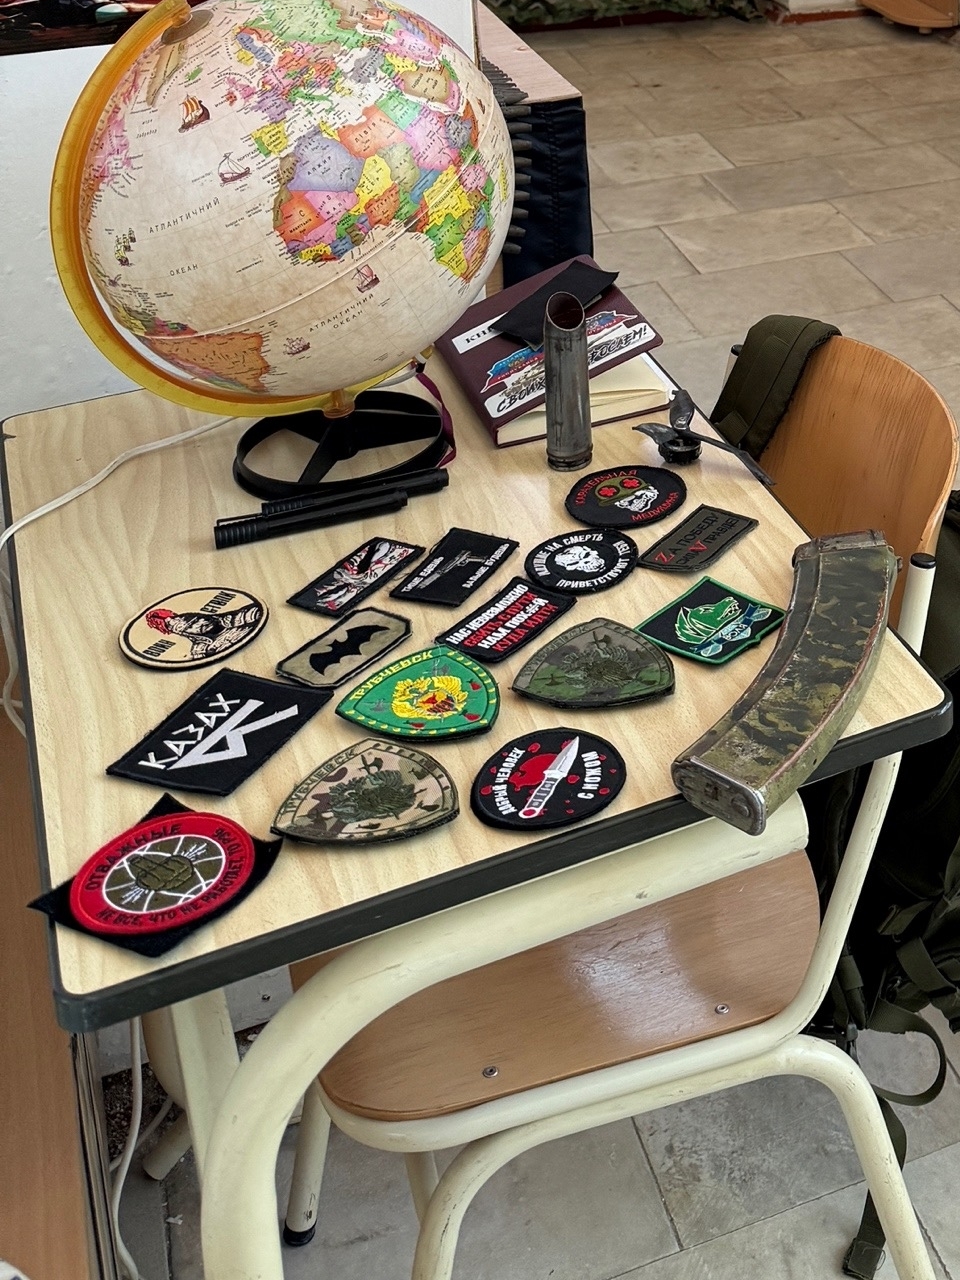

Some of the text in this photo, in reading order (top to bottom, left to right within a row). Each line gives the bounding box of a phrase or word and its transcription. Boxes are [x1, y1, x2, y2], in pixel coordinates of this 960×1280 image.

[307, 155, 332, 176] АЛЖИР
[149, 196, 220, 234] АТЛАНТИЧНИЙ
[169, 263, 199, 277] ОКЕАН
[309, 293, 374, 333] АТЛАНТИЧНИЙ
[333, 310, 363, 329] ОКЕАН
[497, 378, 546, 413] СВОИХ
[575, 470, 637, 507] КАРАТЕЛЬНАЯ
[545, 541, 563, 552] НА
[562, 533, 604, 545] СМЕРТЬ
[679, 512, 719, 546] ПОБЕДУ
[556, 558, 630, 588] ПРИВЕТСТВУЮТ
[446, 583, 529, 645] НАС НЕВОЗМОЖНО
[463, 591, 538, 648] СБИТЬ С ПУТИ
[492, 603, 559, 653] КУДА ИДТИ
[478, 627, 511, 649] НАМ
[349, 650, 433, 701] ТРУБЧЕВСК
[138, 692, 241, 770] КАЗАХ
[283, 748, 360, 815] ТРУБЧЕВСК
[495, 747, 526, 784] ЧЕЛОВЕК
[577, 751, 602, 800] С НОЖОМ
[85, 823, 183, 891] ОТВАЖНЫЕ
[149, 908, 176, 923] ЧТО
[180, 901, 201, 915] НЕ
